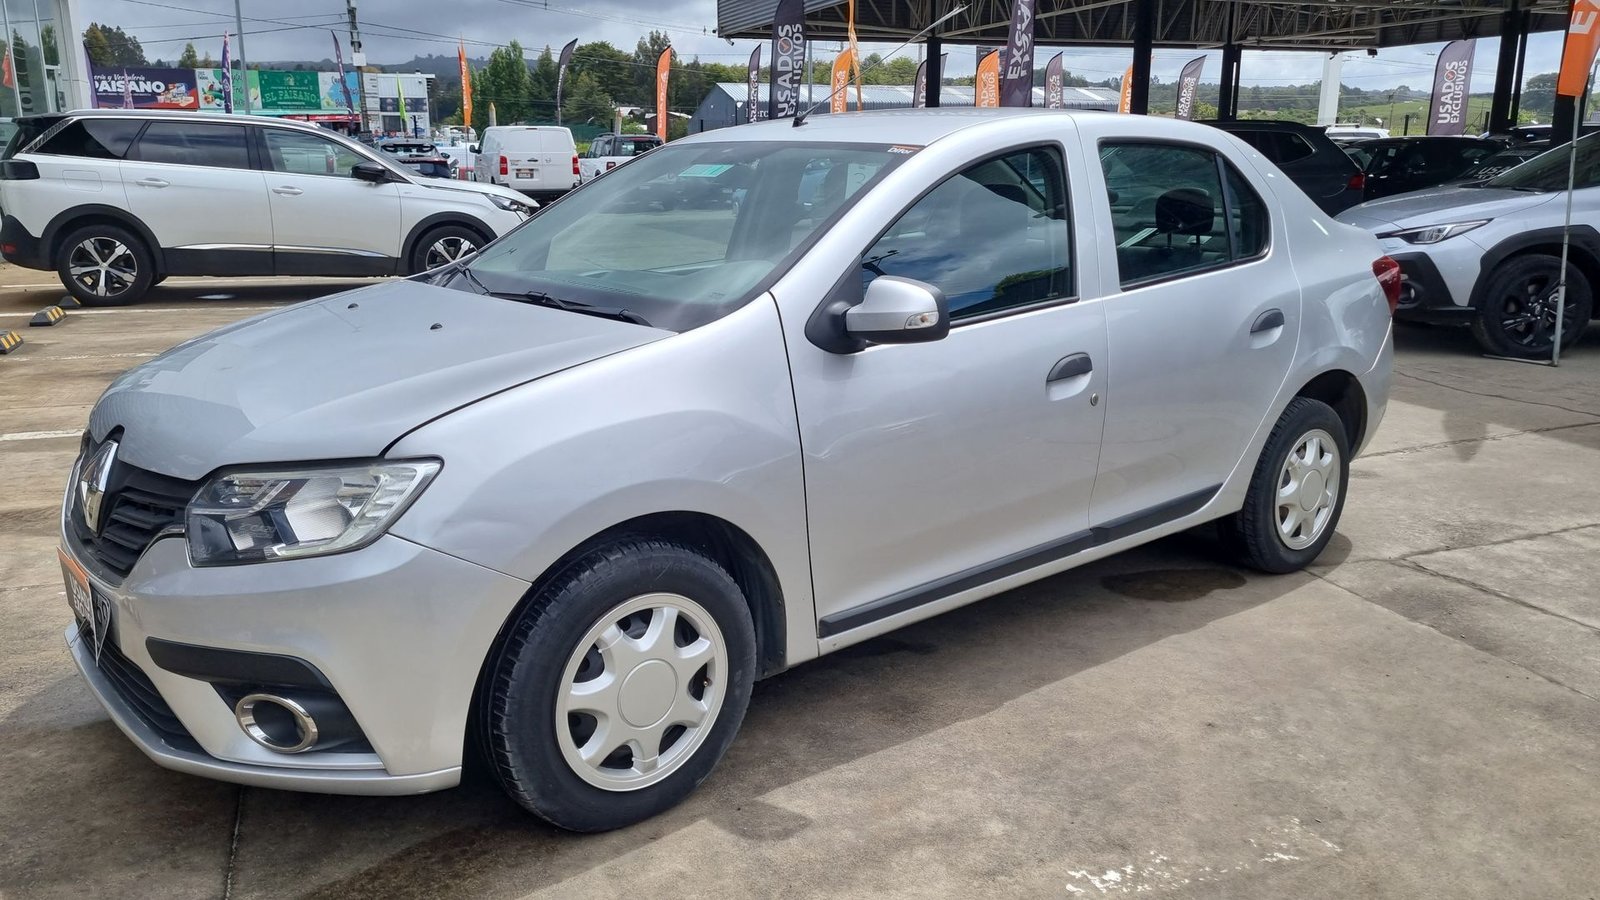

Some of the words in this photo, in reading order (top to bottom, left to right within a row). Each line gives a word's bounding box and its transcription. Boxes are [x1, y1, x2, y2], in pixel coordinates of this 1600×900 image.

[264, 92, 277, 102] EL
[278, 90, 317, 103] PAISANO
[777, 24, 793, 118] USADOS
[1178, 77, 1191, 116] USADOS
[1437, 61, 1458, 124] USADOS
[1450, 60, 1468, 124] EXCLUSIVOS
[1183, 77, 1196, 117] EXCLUSIVOS
